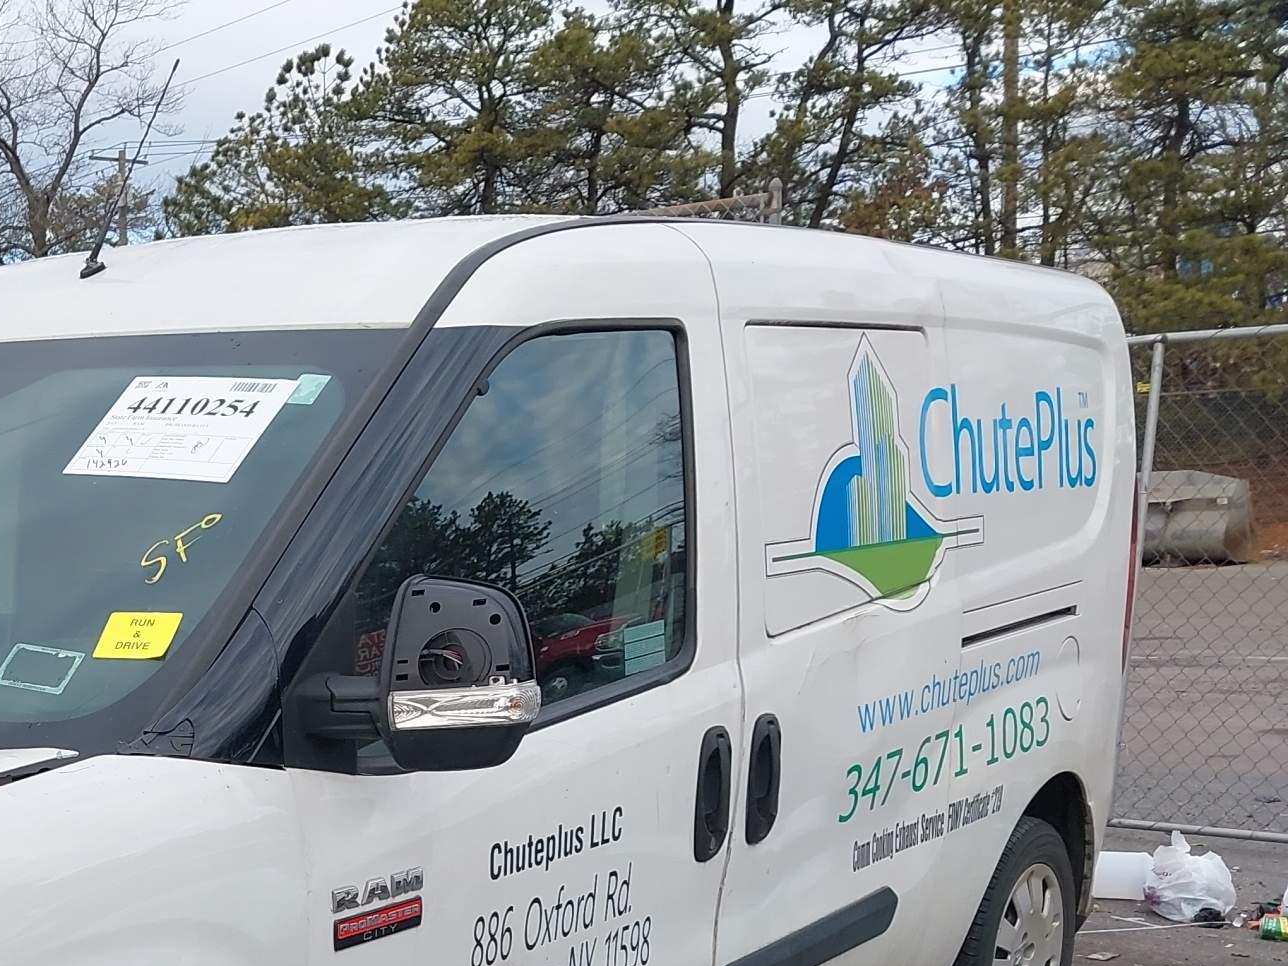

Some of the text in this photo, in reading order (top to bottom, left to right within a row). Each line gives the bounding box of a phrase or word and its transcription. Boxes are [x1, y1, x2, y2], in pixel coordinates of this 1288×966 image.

[127, 396, 261, 418] 44110254
[919, 384, 1097, 498] ChutePlus
[114, 641, 152, 651] DRIVE
[129, 618, 156, 628] RUN
[856, 650, 1041, 734] www.chuteplus.com
[838, 696, 1051, 824] 347-671-1083
[488, 806, 624, 881] Chuteplus LLC
[895, 816, 920, 853] Exhaust
[920, 809, 945, 844] Service
[331, 866, 424, 914] RAM
[523, 872, 599, 951] Oxford
[363, 922, 399, 941] CITY
